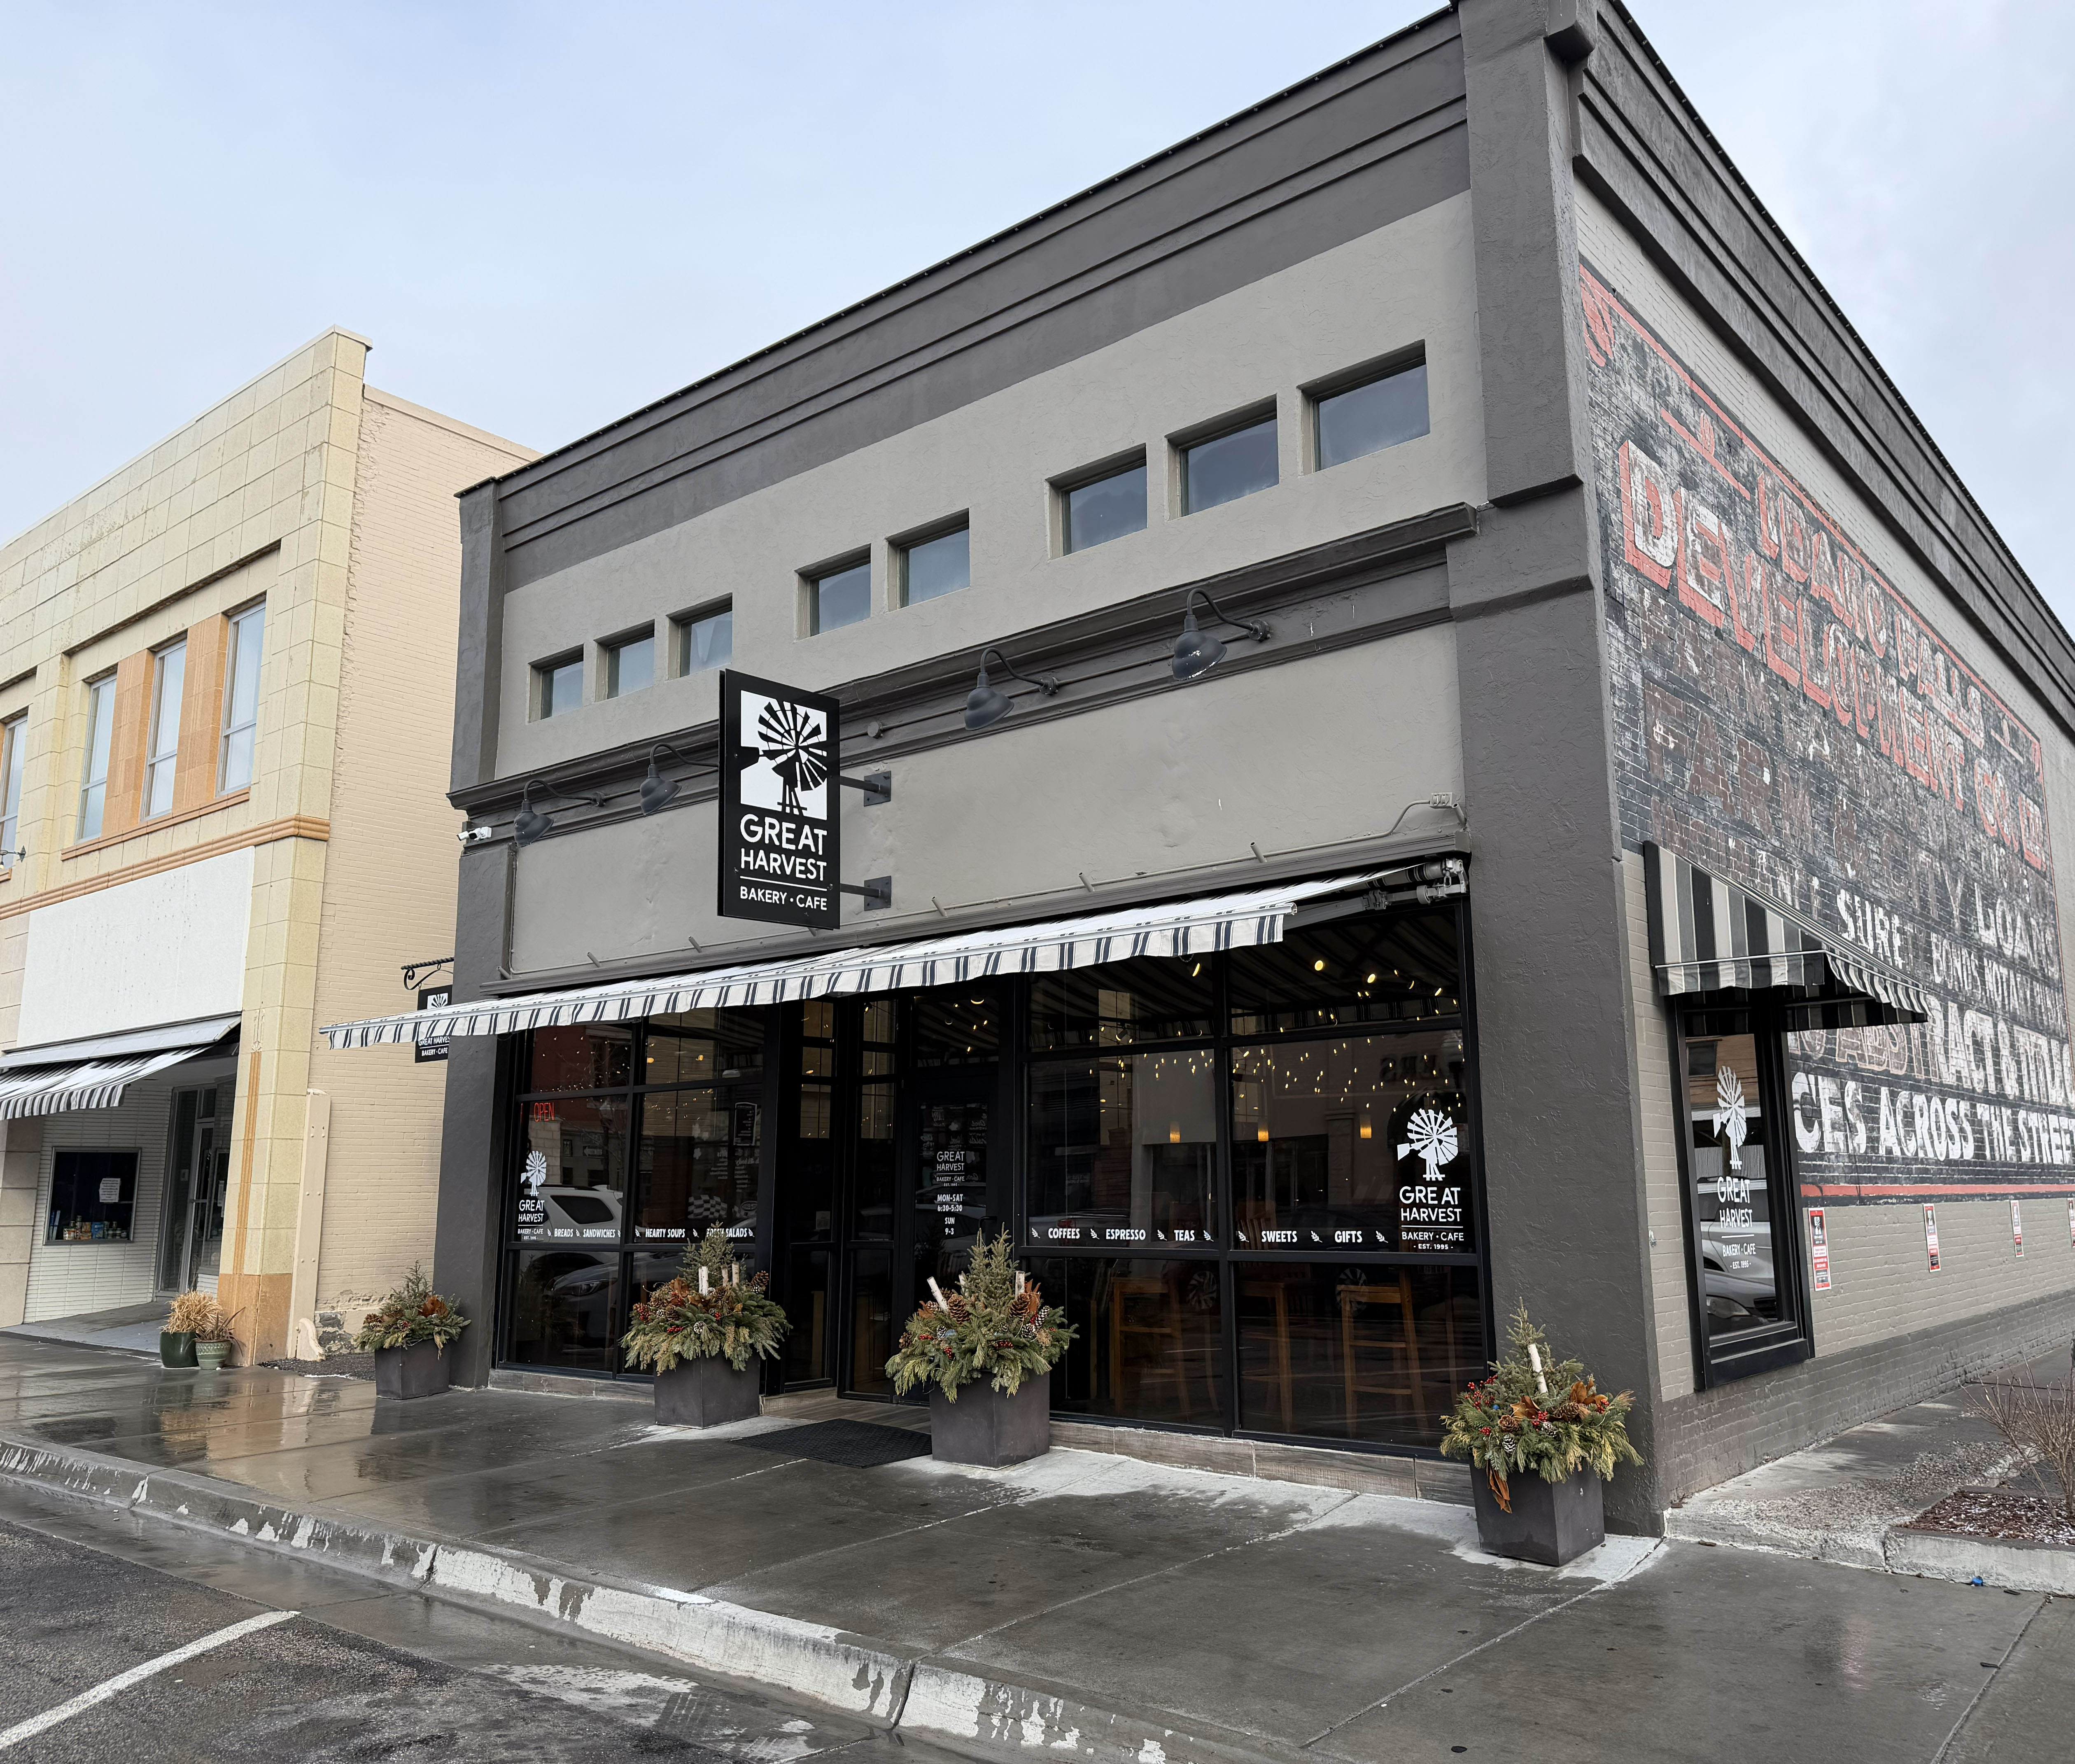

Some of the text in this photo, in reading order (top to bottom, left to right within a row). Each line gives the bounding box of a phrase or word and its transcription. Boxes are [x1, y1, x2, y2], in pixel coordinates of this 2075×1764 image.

[1757, 471, 1891, 659] IDAHO
[1619, 439, 1965, 811] DEVELOPMENT
[740, 814, 827, 855] GREAT
[1645, 681, 1812, 853] FARM
[1975, 882, 2059, 980] LOANS
[740, 848, 826, 881] HARVEST
[740, 887, 827, 910] BAKERY CAFE
[434, 1036, 450, 1044] HARVES
[1997, 1020, 2019, 1100] &
[534, 1102, 555, 1122] OPEN
[1879, 1087, 1975, 1161] ACROSS
[1976, 1103, 2016, 1161] THE
[937, 1151, 965, 1162] GREAT
[937, 1163, 965, 1171] HARVEST
[1400, 1186, 1460, 1204] GREAT
[1717, 1176, 1750, 1204] GREAT
[519, 1199, 545, 1211] GREAT
[518, 1213, 544, 1223] HARVEST
[1401, 1208, 1462, 1222] HARVEST
[1720, 1208, 1753, 1228] HARVEST
[554, 1228, 573, 1237] BREADS
[583, 1229, 616, 1238] SANDWICHES
[645, 1228, 685, 1238] HEARTY SOUPS
[726, 1228, 748, 1238] SALADS
[1048, 1228, 1080, 1239] COFFEES
[1106, 1229, 1146, 1240] ESPRESSO
[1174, 1230, 1195, 1241] TEAS
[1261, 1231, 1297, 1243] SWEETS
[1335, 1231, 1363, 1243] GIFTS
[1402, 1232, 1464, 1241] BAKERY CAFE
[1723, 1243, 1756, 1257] BAKERY CAFE
